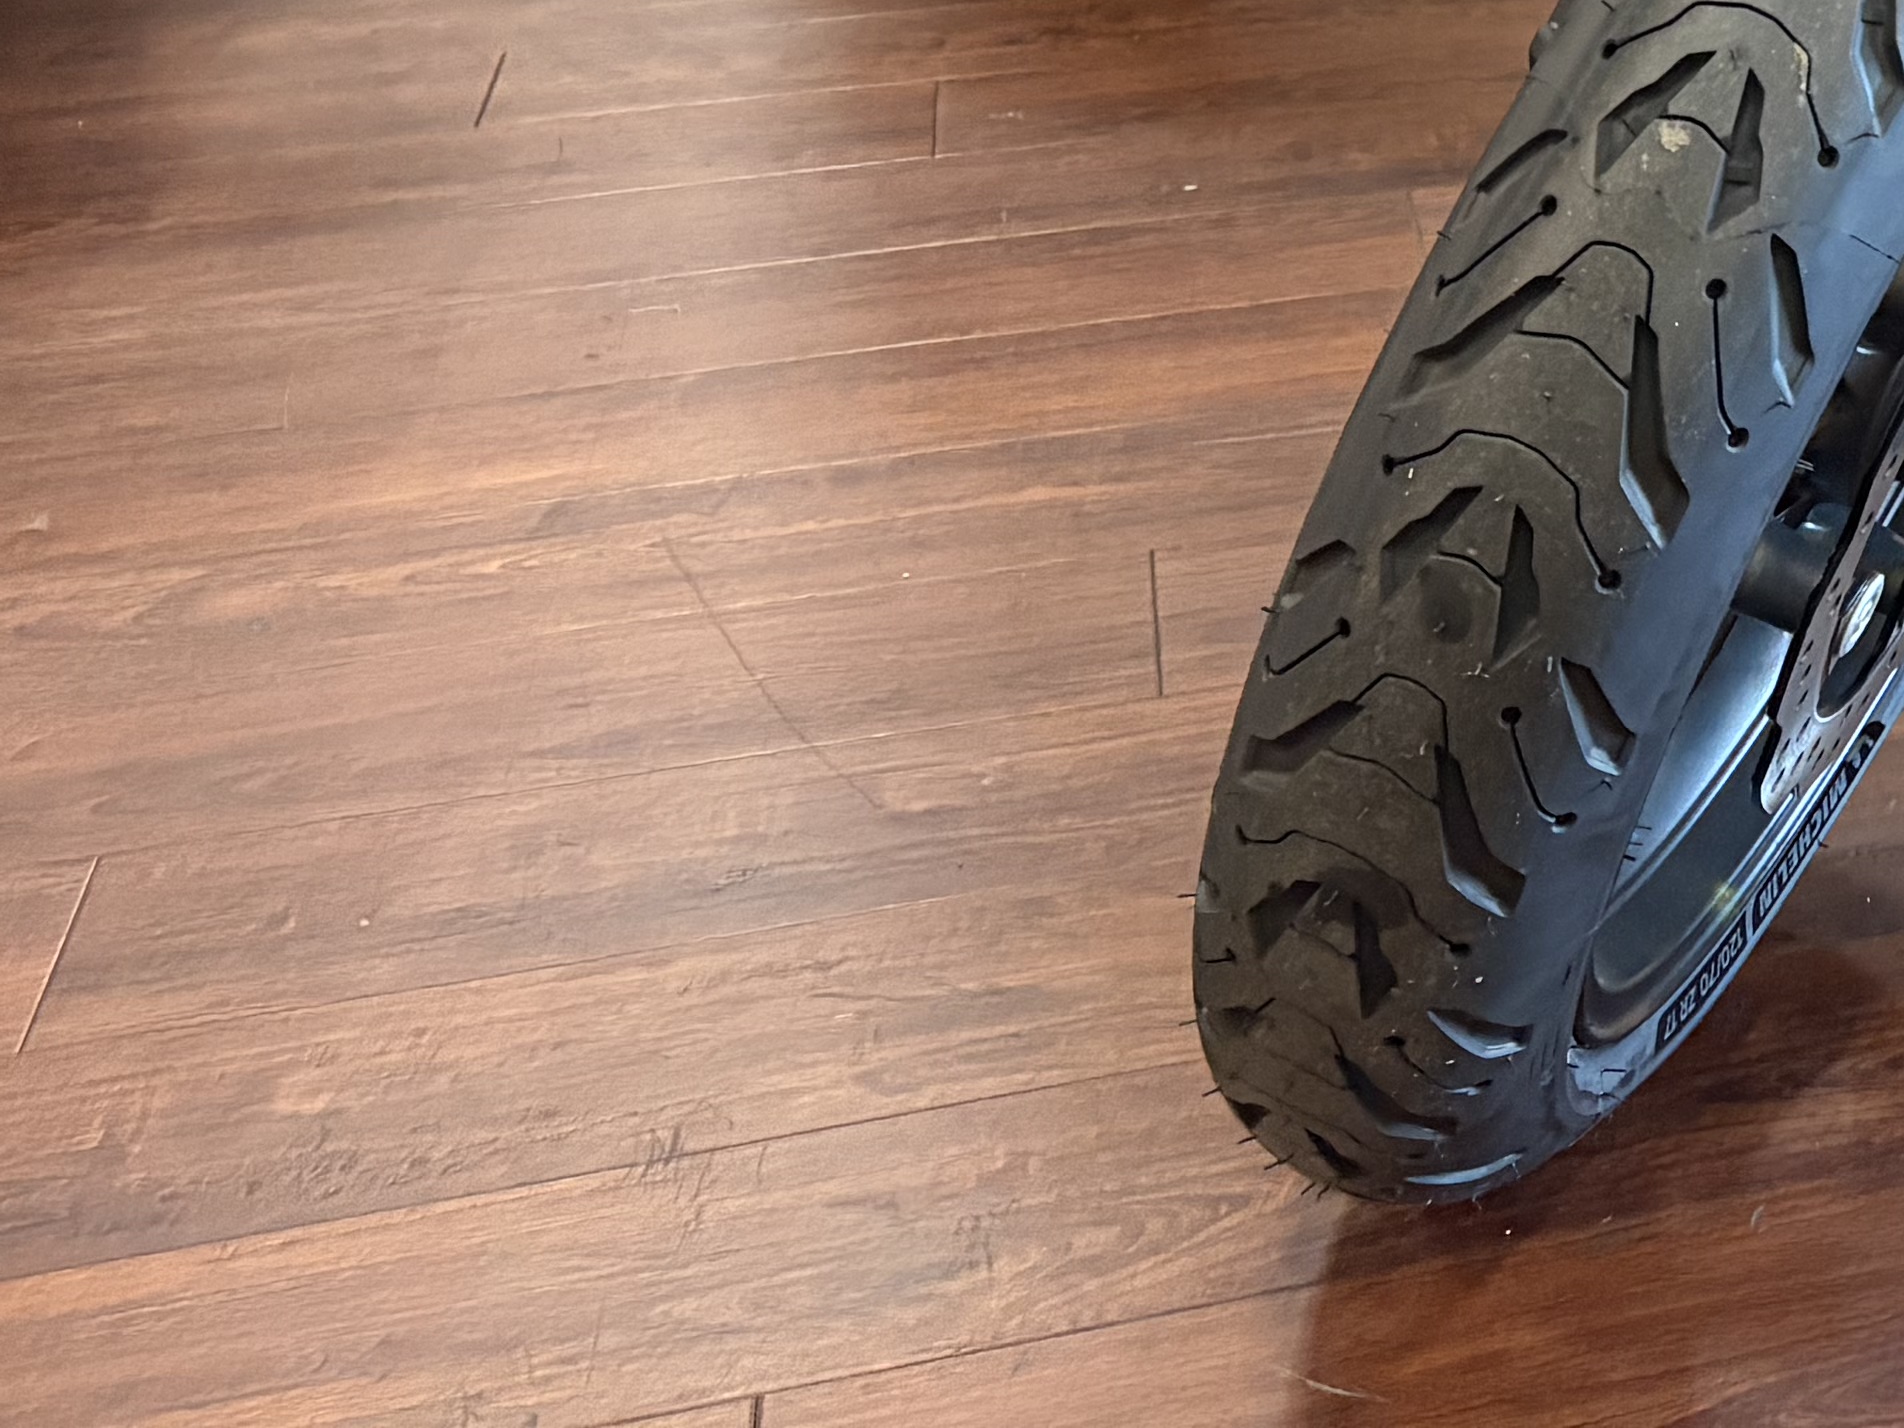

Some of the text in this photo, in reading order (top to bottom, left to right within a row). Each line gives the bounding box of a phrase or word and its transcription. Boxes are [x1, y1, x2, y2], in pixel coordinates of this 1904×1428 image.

[1758, 767, 1850, 920] MICHELIN
[1663, 924, 1745, 1041] 120/70 ZR 17
